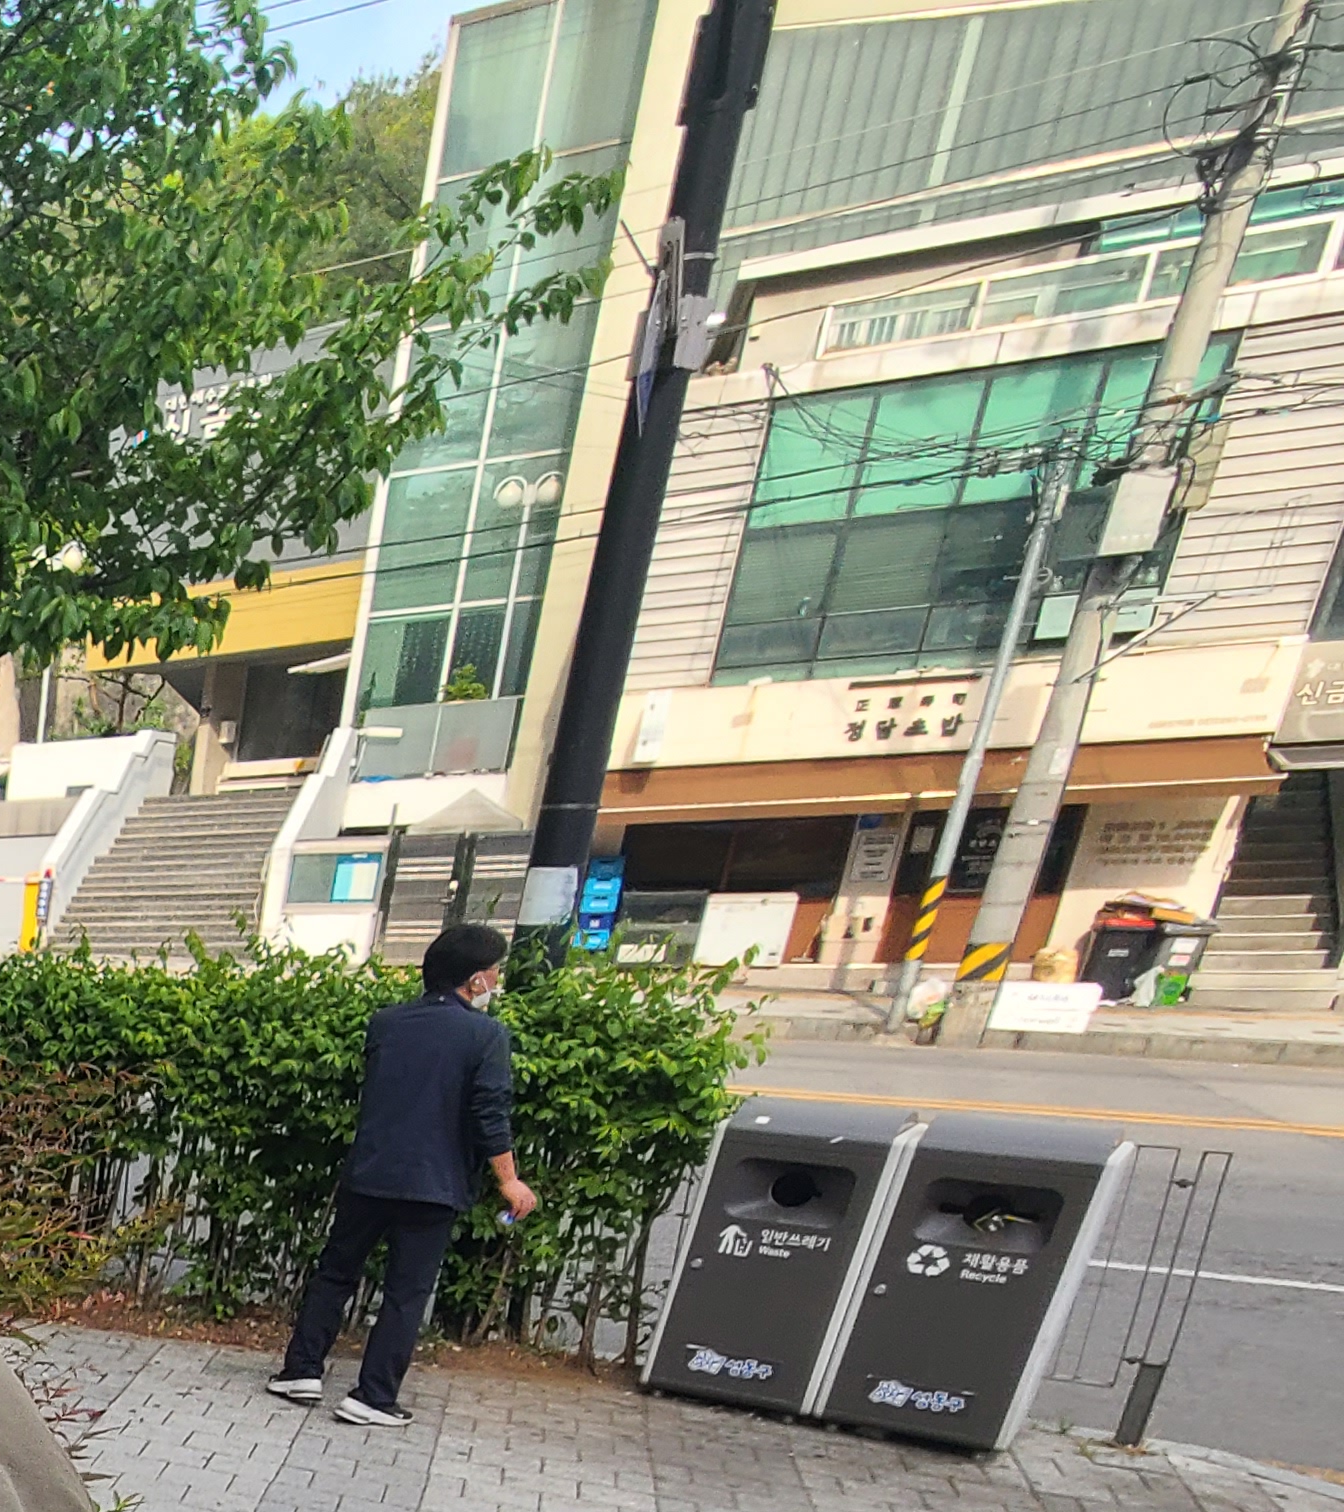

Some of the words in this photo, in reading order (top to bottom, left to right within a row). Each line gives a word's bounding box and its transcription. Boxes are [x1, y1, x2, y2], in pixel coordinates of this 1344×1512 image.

[761, 1228, 831, 1252] 일반쓰레기
[759, 1245, 790, 1259] Waste
[961, 1252, 1029, 1275] 재활용품
[959, 1268, 1008, 1284] Recycle
[724, 1359, 773, 1379] 성동구
[910, 1390, 965, 1413] 성동구
